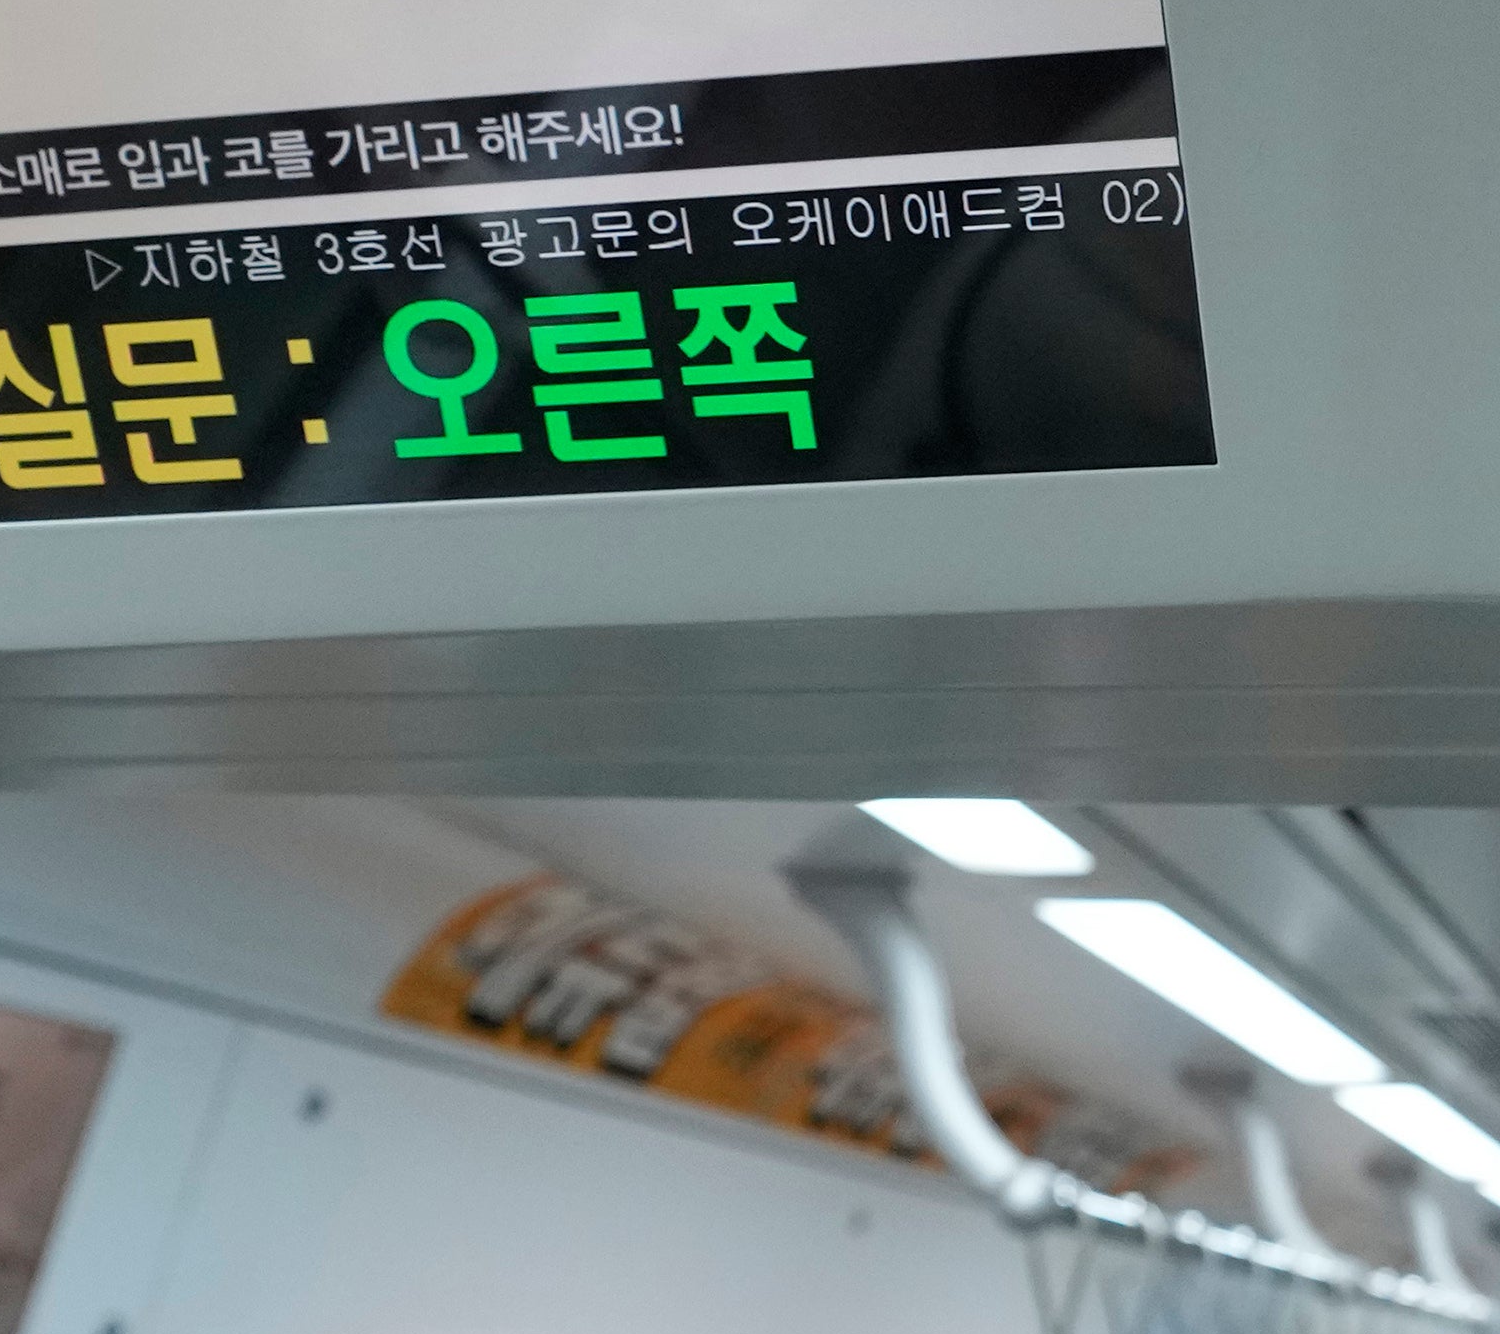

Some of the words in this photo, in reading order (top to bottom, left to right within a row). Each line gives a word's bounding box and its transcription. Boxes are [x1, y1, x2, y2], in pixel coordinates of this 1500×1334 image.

[117, 136, 211, 190] 입과
[223, 129, 315, 180] 코를
[326, 120, 469, 174] 가리고
[477, 103, 685, 162] 해주세요!
[133, 234, 286, 288] 지하철
[315, 223, 446, 275] 3호선
[480, 207, 694, 267] 광고문의
[731, 182, 1065, 247] 오케이애드컴
[1103, 172, 1184, 225] 02)
[382, 281, 819, 462] 오른쪽
